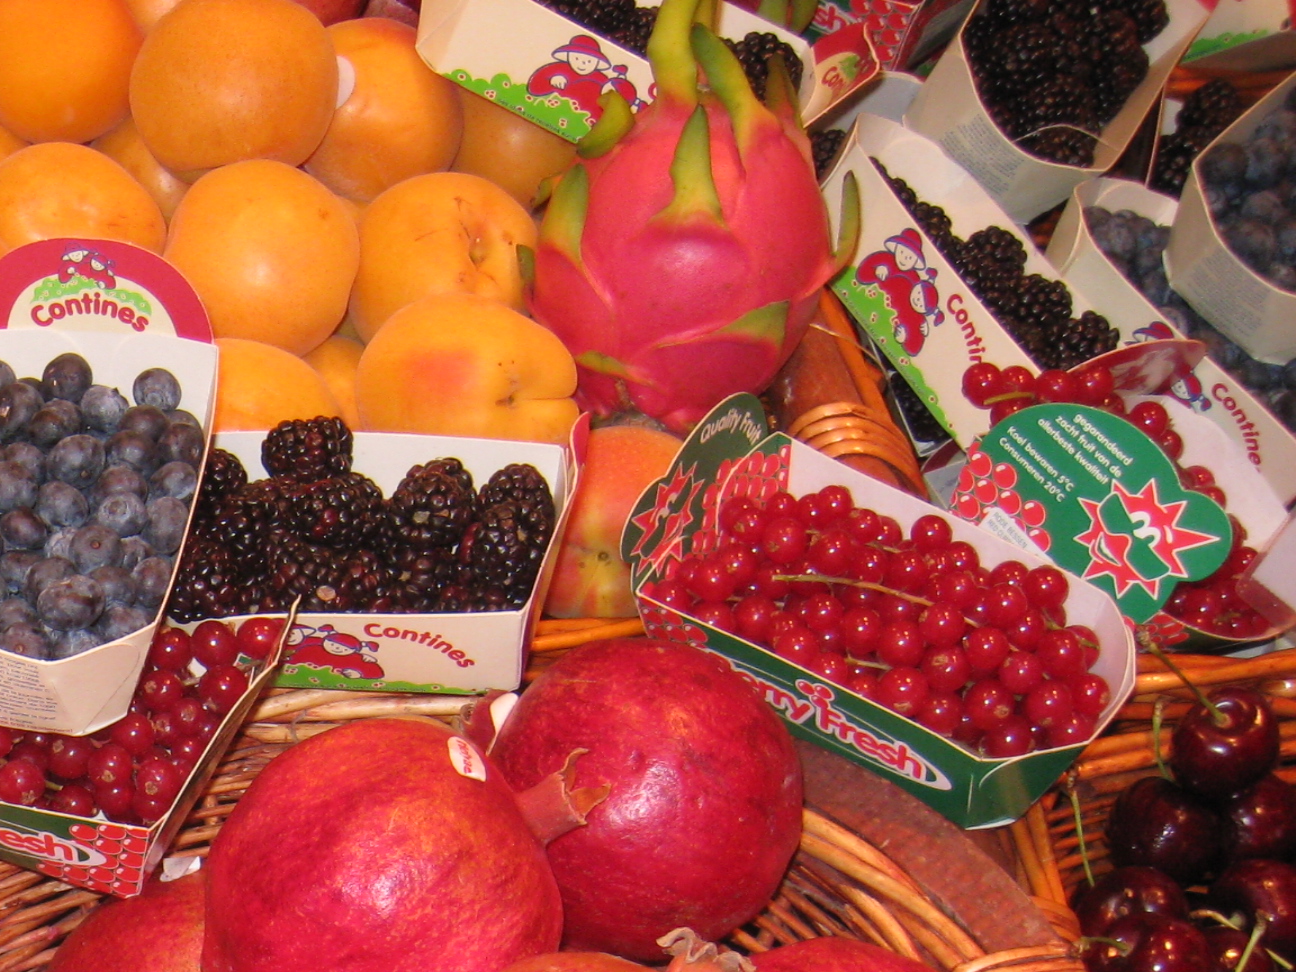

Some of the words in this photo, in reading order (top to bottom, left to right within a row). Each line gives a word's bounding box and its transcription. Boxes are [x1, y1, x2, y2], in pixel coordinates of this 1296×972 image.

[30, 292, 149, 332] Contines
[699, 407, 743, 444] Quality
[1072, 413, 1134, 467] gegarandeerd
[1211, 382, 1262, 474] Contine
[999, 437, 1045, 485] Consumeren
[1006, 425, 1028, 447] Koel
[1024, 441, 1059, 478] bewaren
[1077, 434, 1097, 453] fruit
[1108, 465, 1123, 479] de
[363, 622, 475, 668] Contines
[813, 698, 926, 781] Fresh
